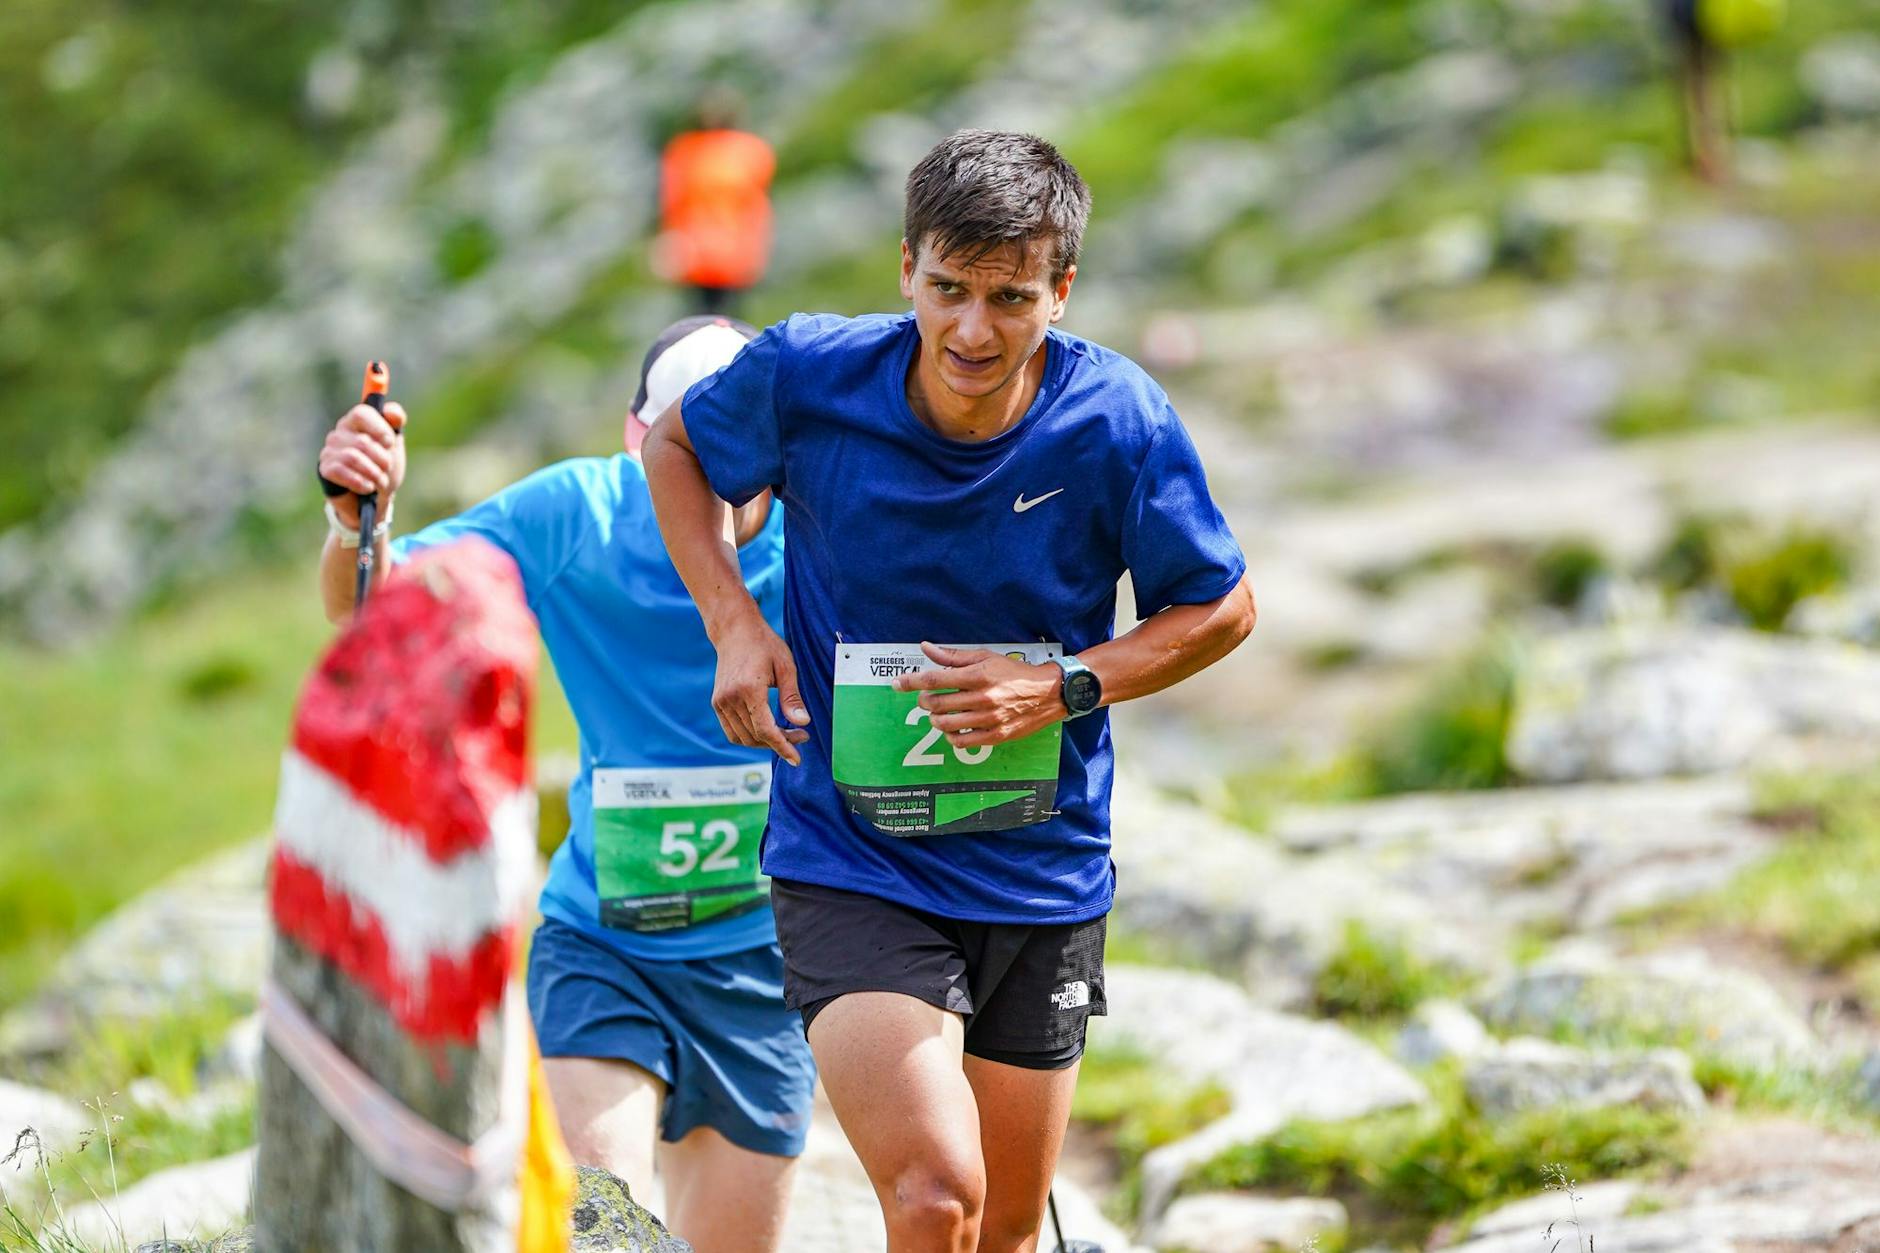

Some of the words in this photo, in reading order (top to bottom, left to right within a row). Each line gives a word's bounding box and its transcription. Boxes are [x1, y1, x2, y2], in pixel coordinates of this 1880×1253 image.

[870, 657, 905, 665] SCHLEGEIS
[882, 790, 912, 798] emergency
[900, 807, 930, 815] Emergency
[894, 825, 914, 833] control
[660, 820, 740, 877] 52
[1064, 982, 1078, 993] THE
[1051, 990, 1078, 1003] NORTH
[1058, 999, 1078, 1010] FACE
